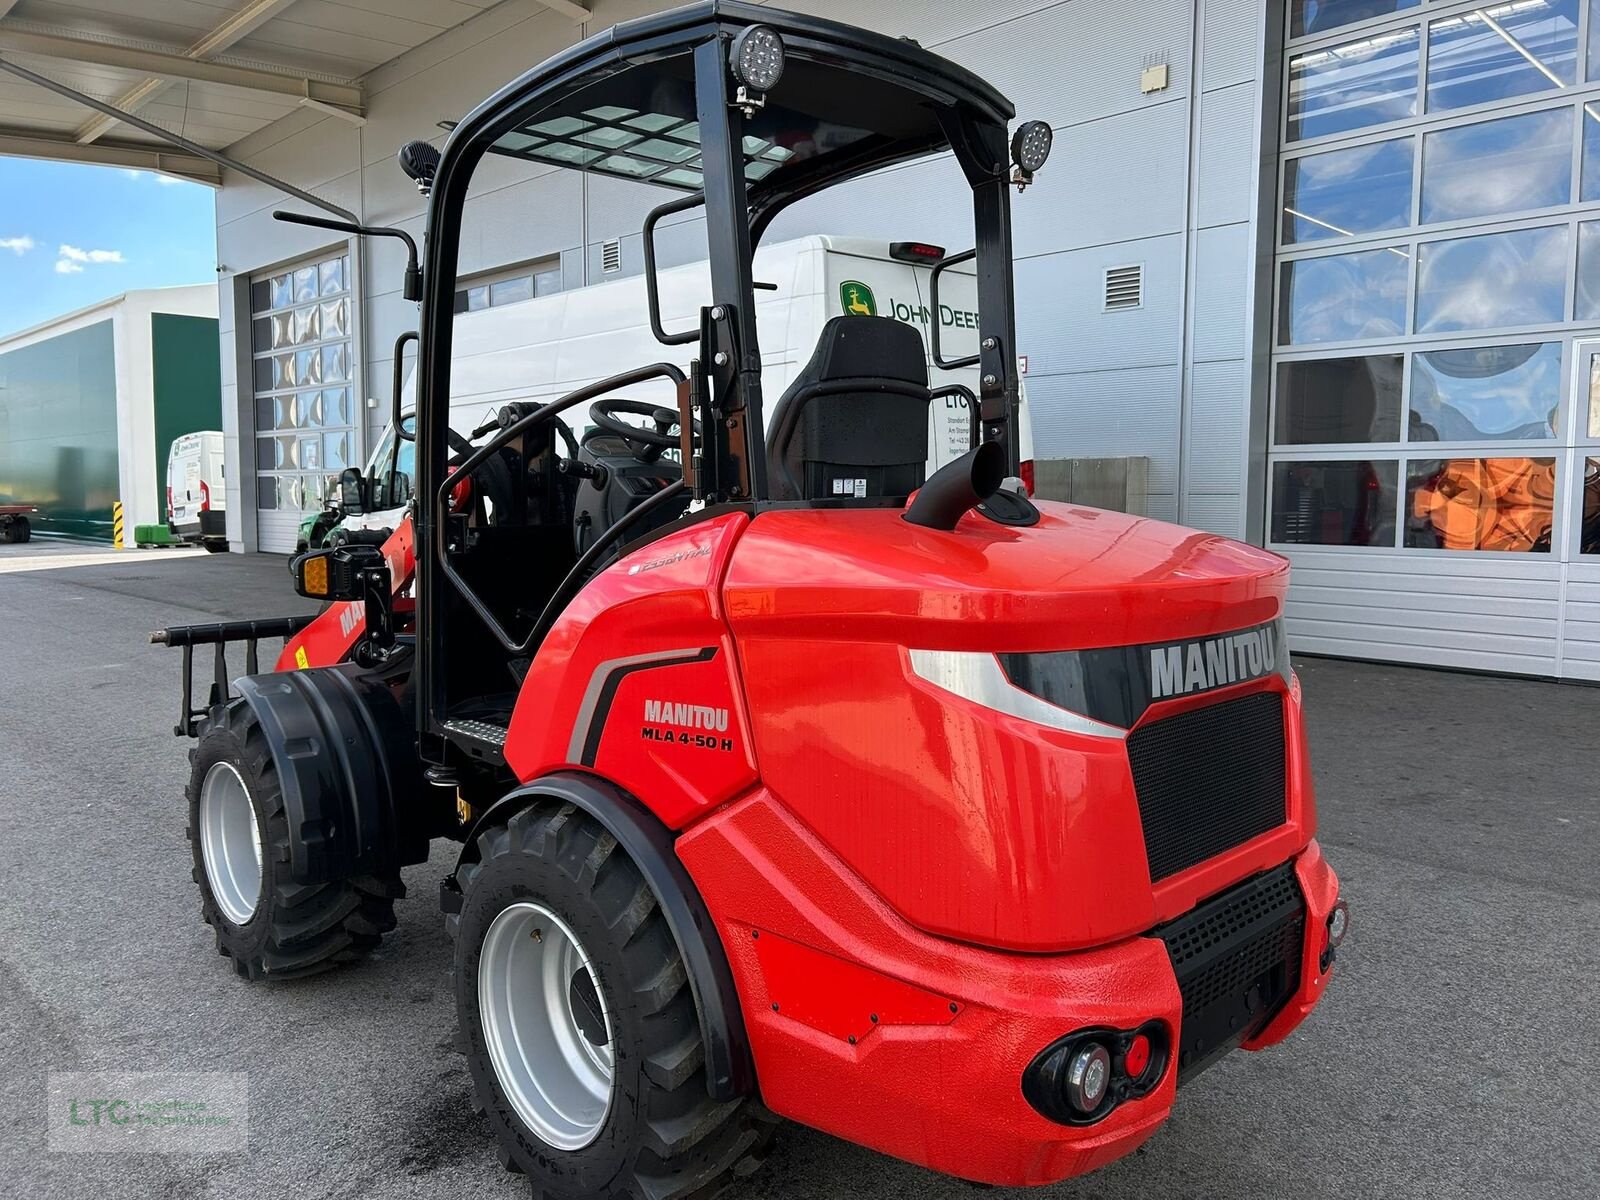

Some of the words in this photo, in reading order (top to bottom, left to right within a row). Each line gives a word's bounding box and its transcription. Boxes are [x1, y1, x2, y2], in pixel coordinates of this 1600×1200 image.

[956, 426, 969, 435] Stamp
[1150, 627, 1275, 698] MANITOU
[644, 699, 728, 732] MANITOU
[641, 727, 675, 743] MLA
[678, 732, 717, 749] 4-50
[720, 738, 733, 752] H
